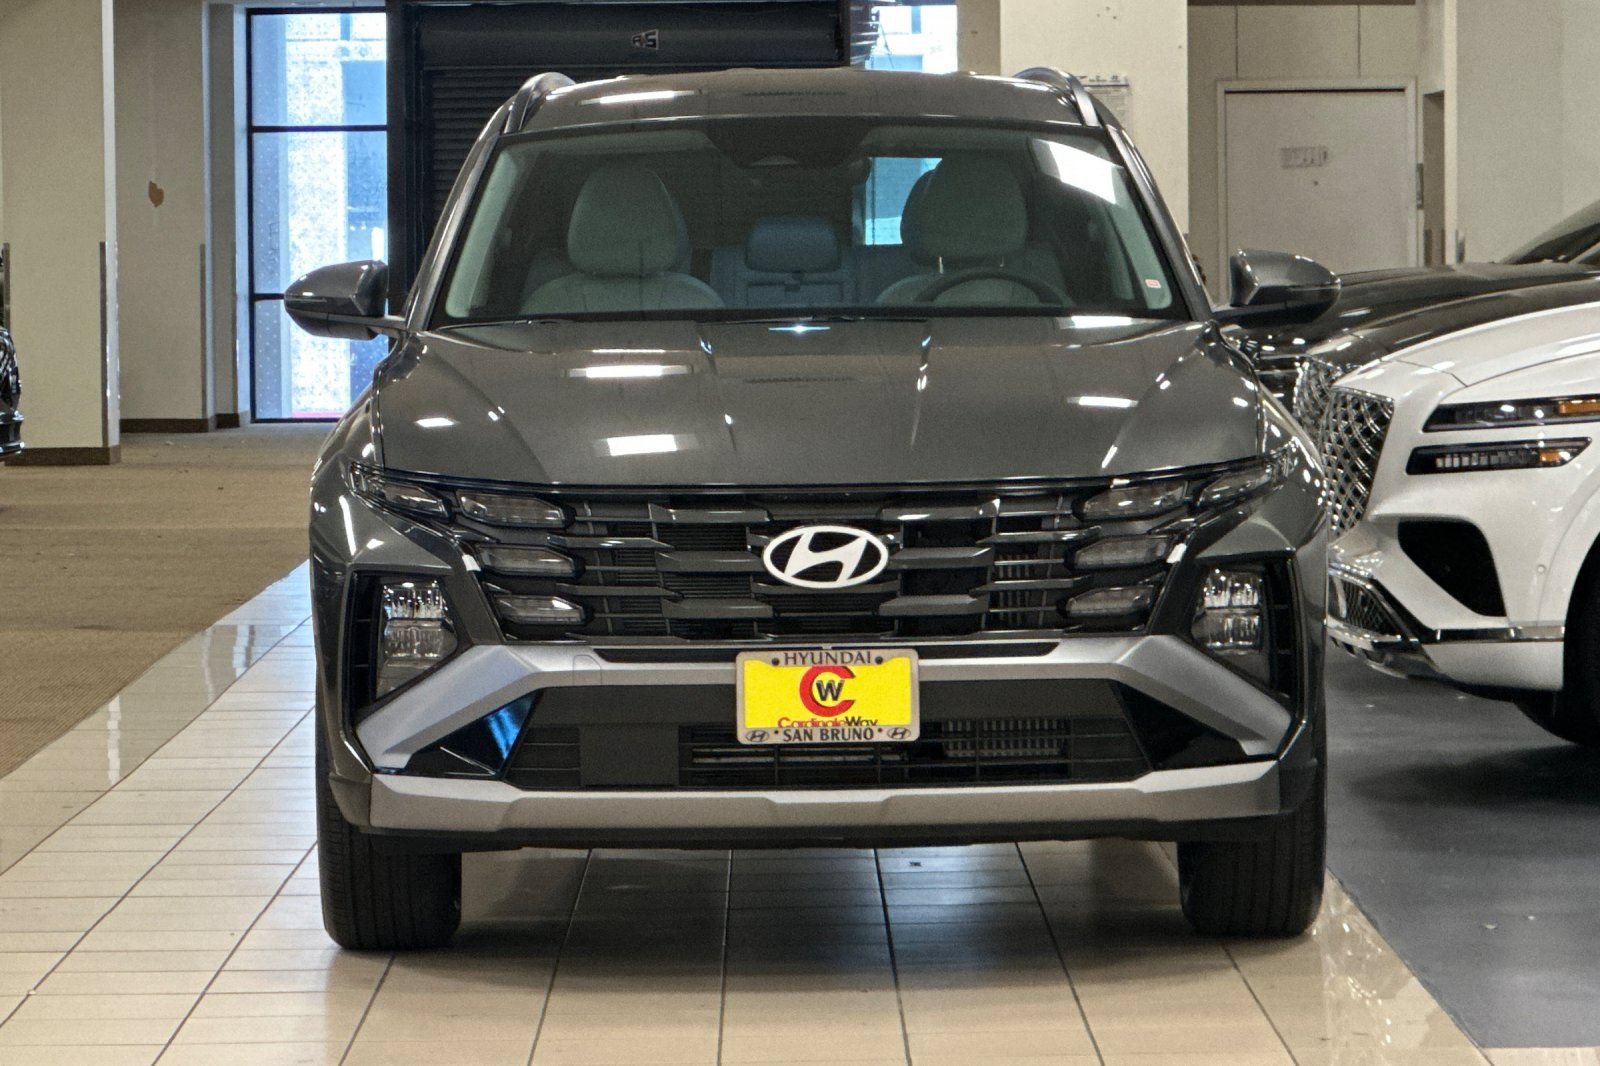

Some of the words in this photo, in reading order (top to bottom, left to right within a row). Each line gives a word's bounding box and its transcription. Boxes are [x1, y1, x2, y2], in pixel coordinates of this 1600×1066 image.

[784, 651, 871, 665] HYUNDAI
[783, 728, 813, 742] SAN
[820, 727, 874, 741] BRUNO
